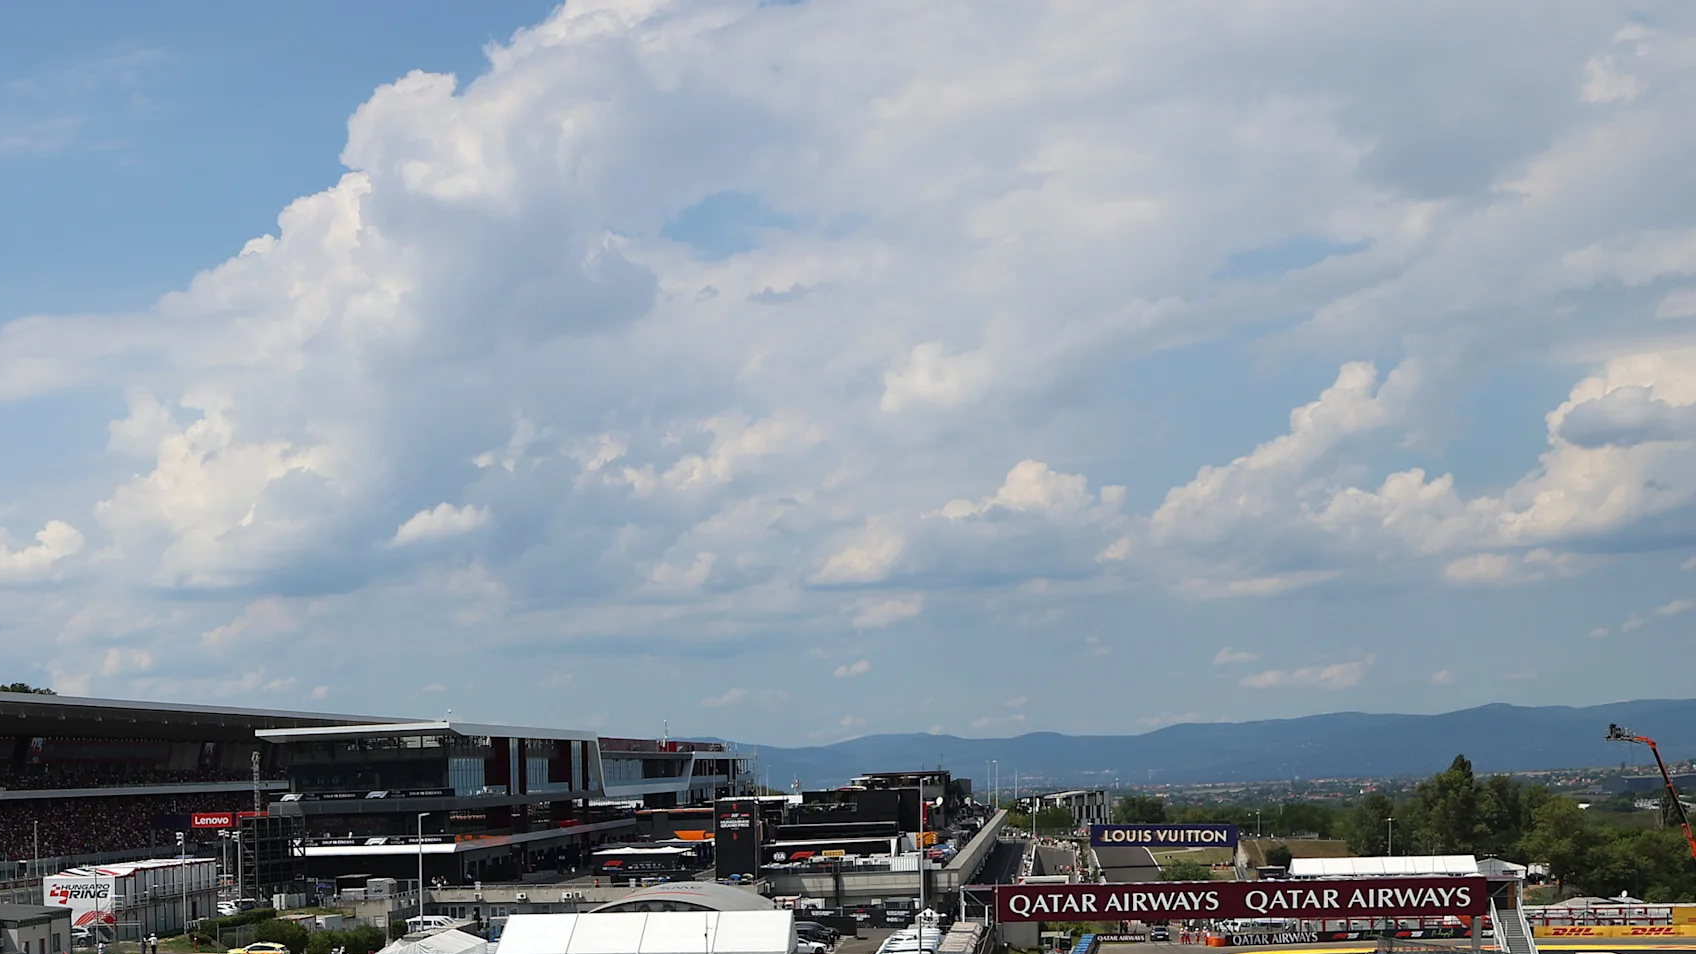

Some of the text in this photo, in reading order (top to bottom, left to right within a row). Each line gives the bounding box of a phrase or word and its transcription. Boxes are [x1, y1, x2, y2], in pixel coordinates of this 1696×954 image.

[194, 816, 229, 826] Lenovo
[1102, 829, 1228, 843] LOUIS VUITTON
[69, 890, 108, 899] RING
[1245, 887, 1471, 913] QATAR AIRWAYS
[1009, 891, 1220, 917] QATAR AIRWAYS
[1232, 932, 1318, 946] QATAR AIRWAYS
